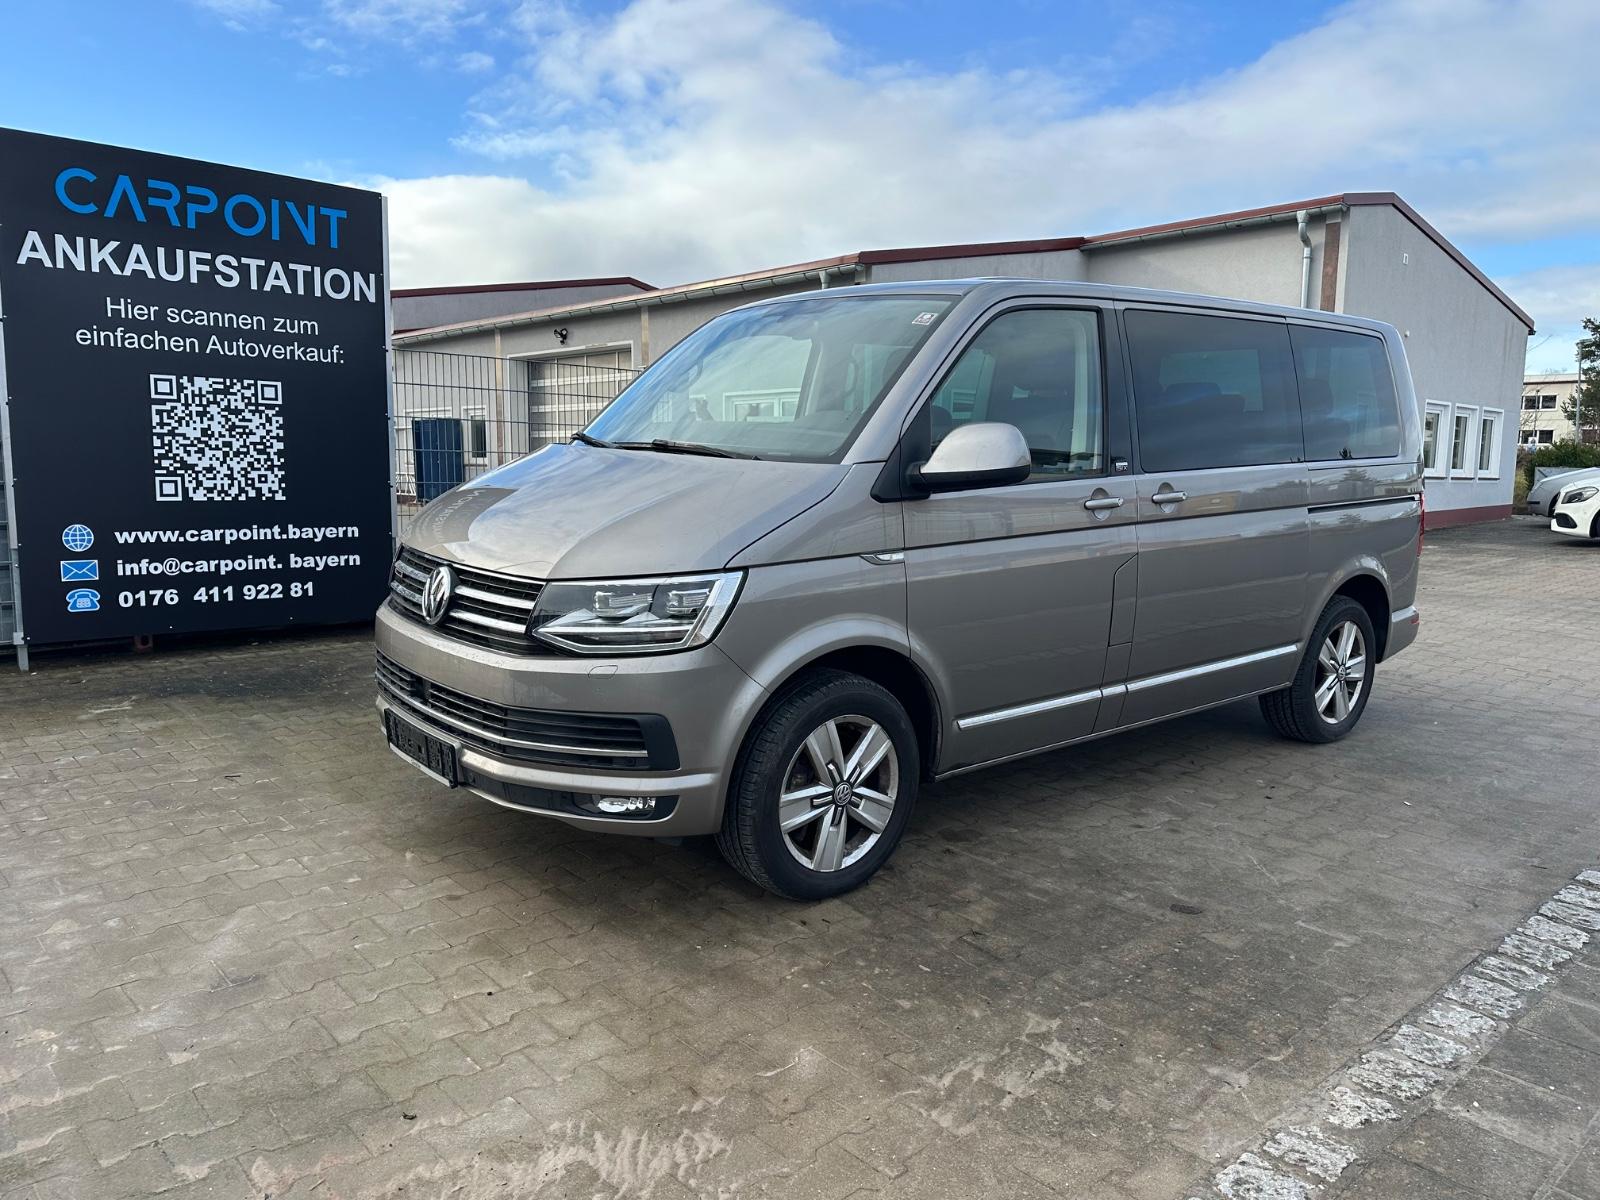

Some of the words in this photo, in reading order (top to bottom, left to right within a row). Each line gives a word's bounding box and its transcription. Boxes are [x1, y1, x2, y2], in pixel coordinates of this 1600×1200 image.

[54, 167, 348, 249] CARPOINT
[16, 230, 376, 303] ANKAUFSTATION
[106, 296, 159, 321] Hier
[166, 307, 266, 331] scannen
[273, 317, 319, 336] zum
[75, 325, 199, 353] einfachen
[205, 334, 345, 364] Autoverkauf:
[114, 524, 360, 545] www.carpoint.bayern
[116, 555, 283, 577] info@carpoint.
[289, 552, 361, 571] bayern
[118, 588, 179, 608] 0176
[193, 585, 234, 604] 411
[242, 583, 284, 600] 922
[289, 581, 314, 598] 81
